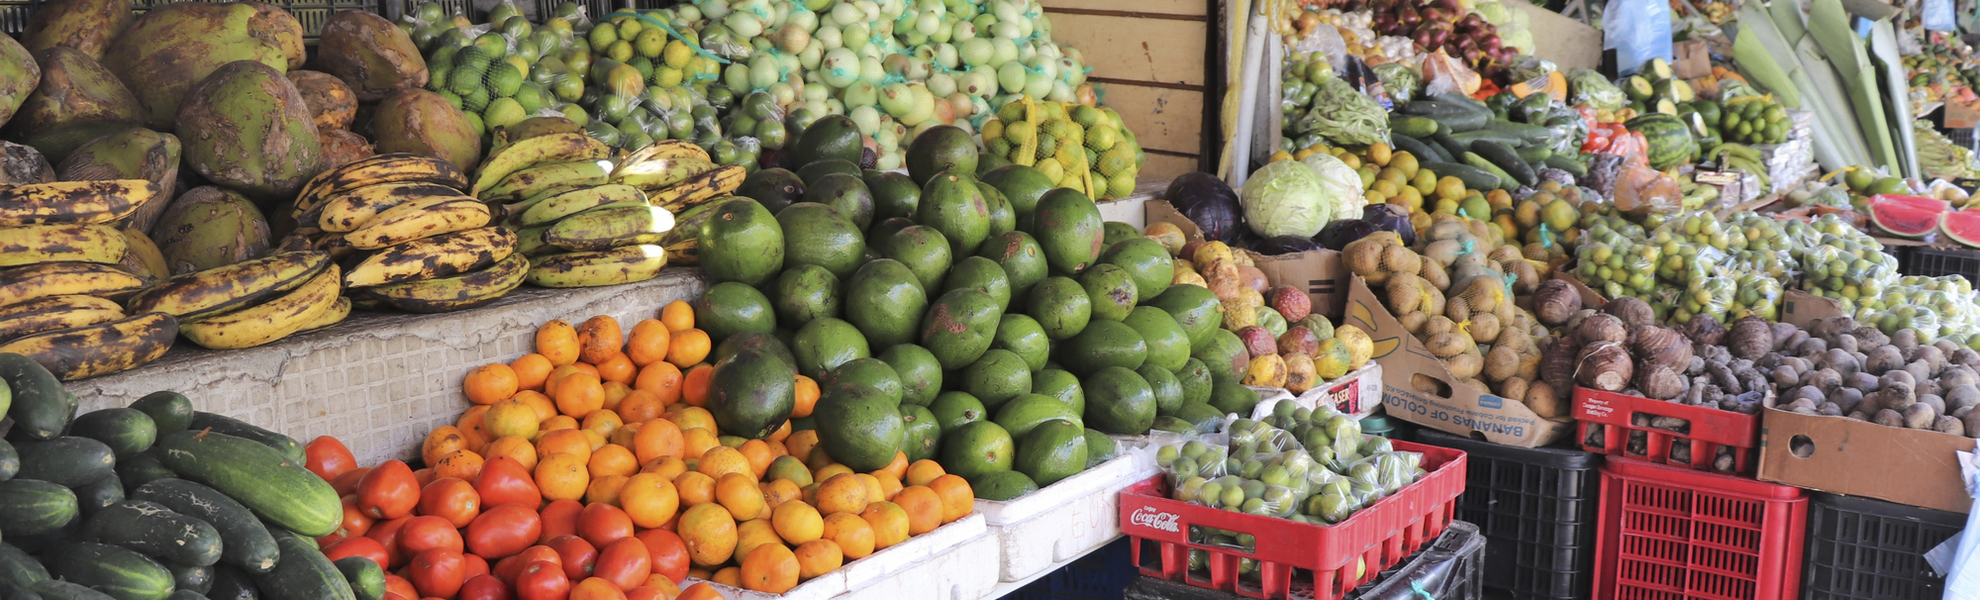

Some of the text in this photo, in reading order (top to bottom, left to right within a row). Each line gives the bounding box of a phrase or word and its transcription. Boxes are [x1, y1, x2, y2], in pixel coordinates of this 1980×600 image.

[1430, 410, 1449, 421] OF
[1508, 416, 1536, 425] Packed
[1453, 415, 1524, 437] BANANAS
[1143, 505, 1157, 513] Enjoy
[1130, 508, 1180, 532] Coca-Cola
